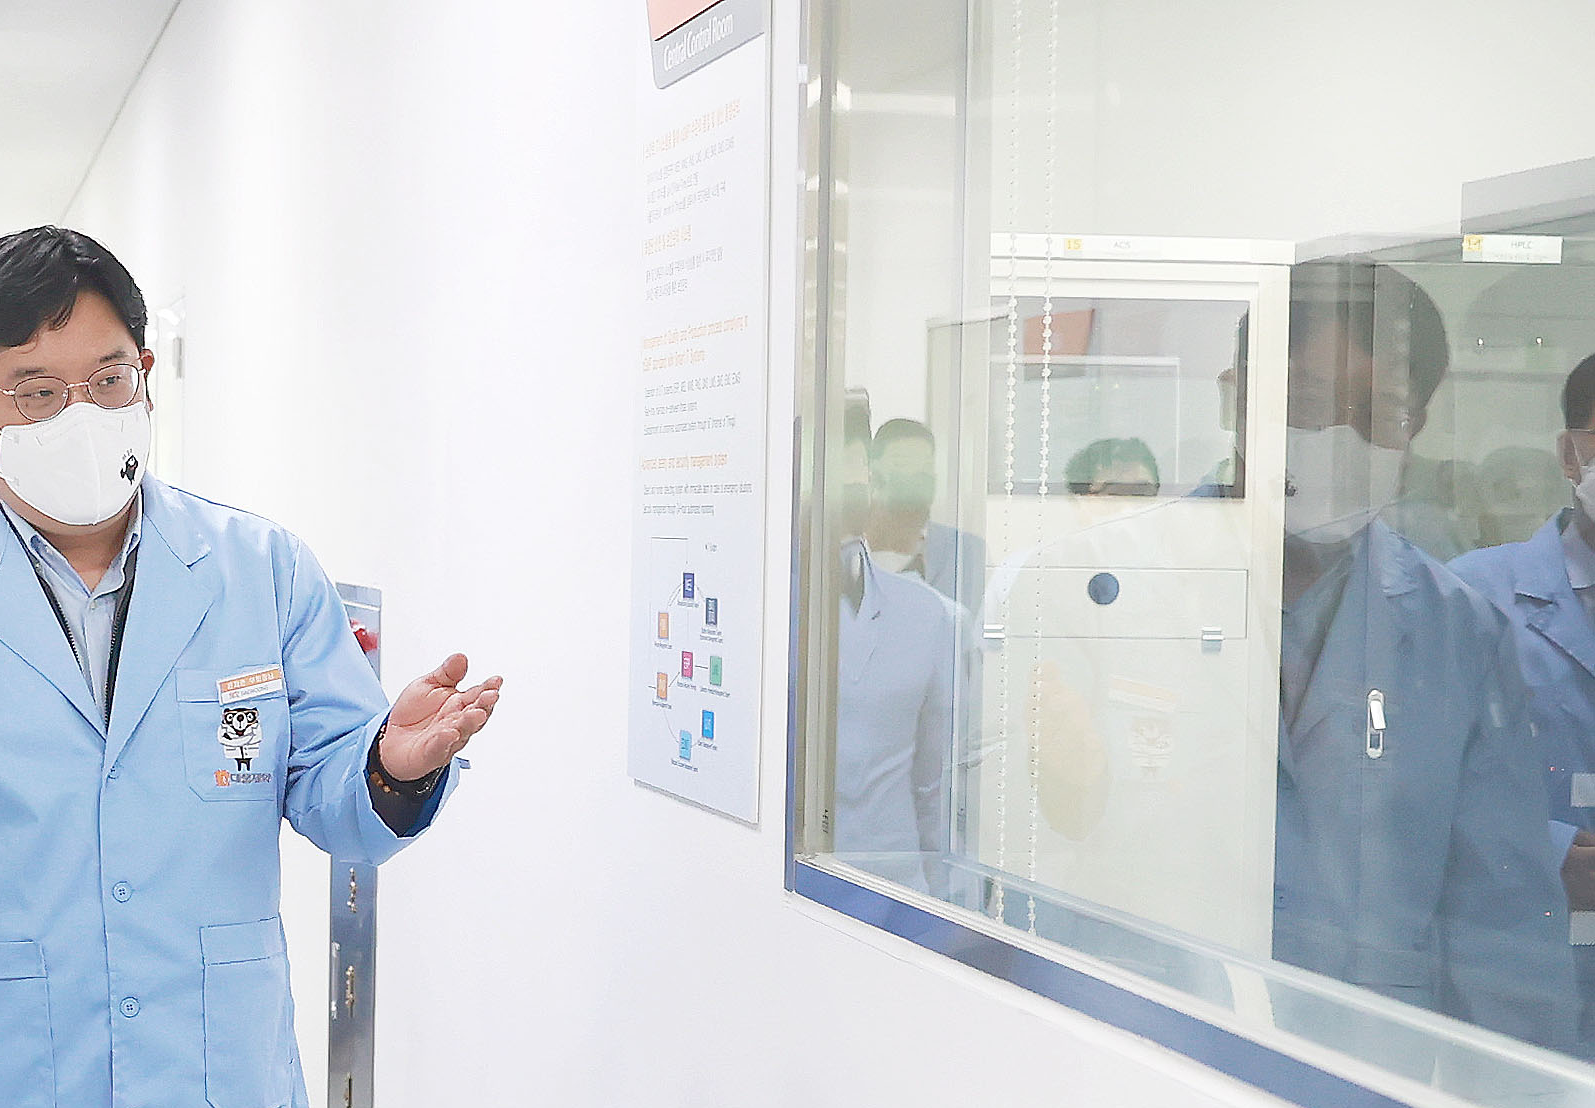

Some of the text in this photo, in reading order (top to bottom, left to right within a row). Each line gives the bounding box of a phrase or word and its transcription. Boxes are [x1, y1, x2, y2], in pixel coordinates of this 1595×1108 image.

[664, 14, 733, 71] Central Control Room
